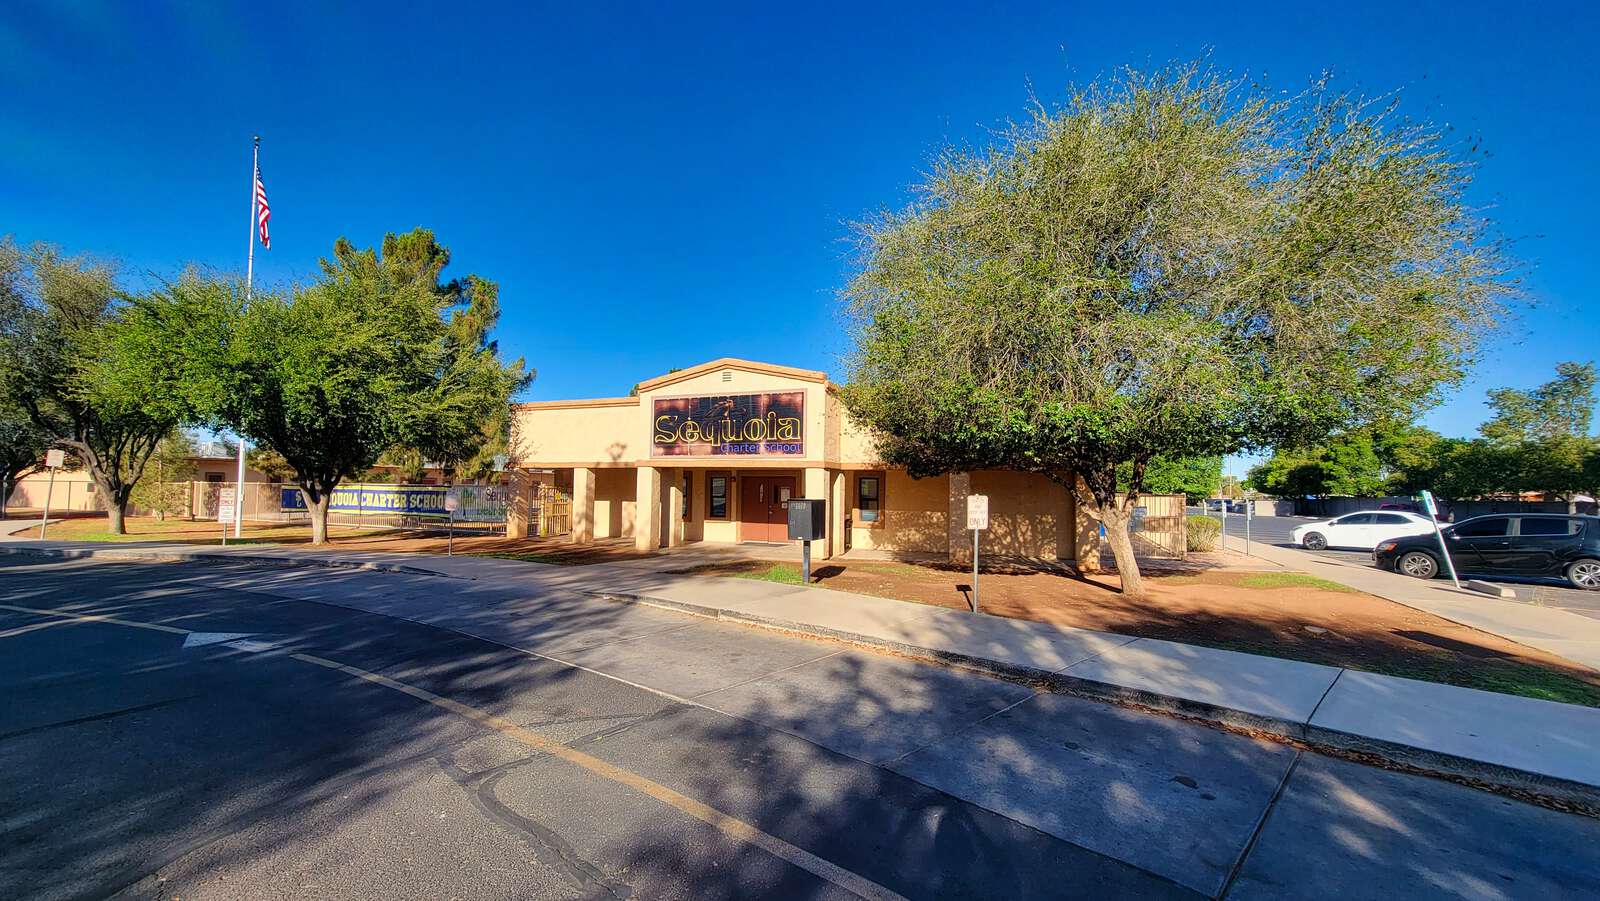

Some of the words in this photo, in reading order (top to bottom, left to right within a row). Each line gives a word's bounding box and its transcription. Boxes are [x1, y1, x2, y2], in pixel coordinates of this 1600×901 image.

[654, 411, 801, 446] Sequoia
[720, 443, 760, 452] Charter
[764, 443, 801, 452] School
[329, 492, 360, 507] QUOIA
[361, 493, 407, 508] CHARTER
[409, 494, 445, 509] SCHOO
[969, 517, 986, 526] ONLY
